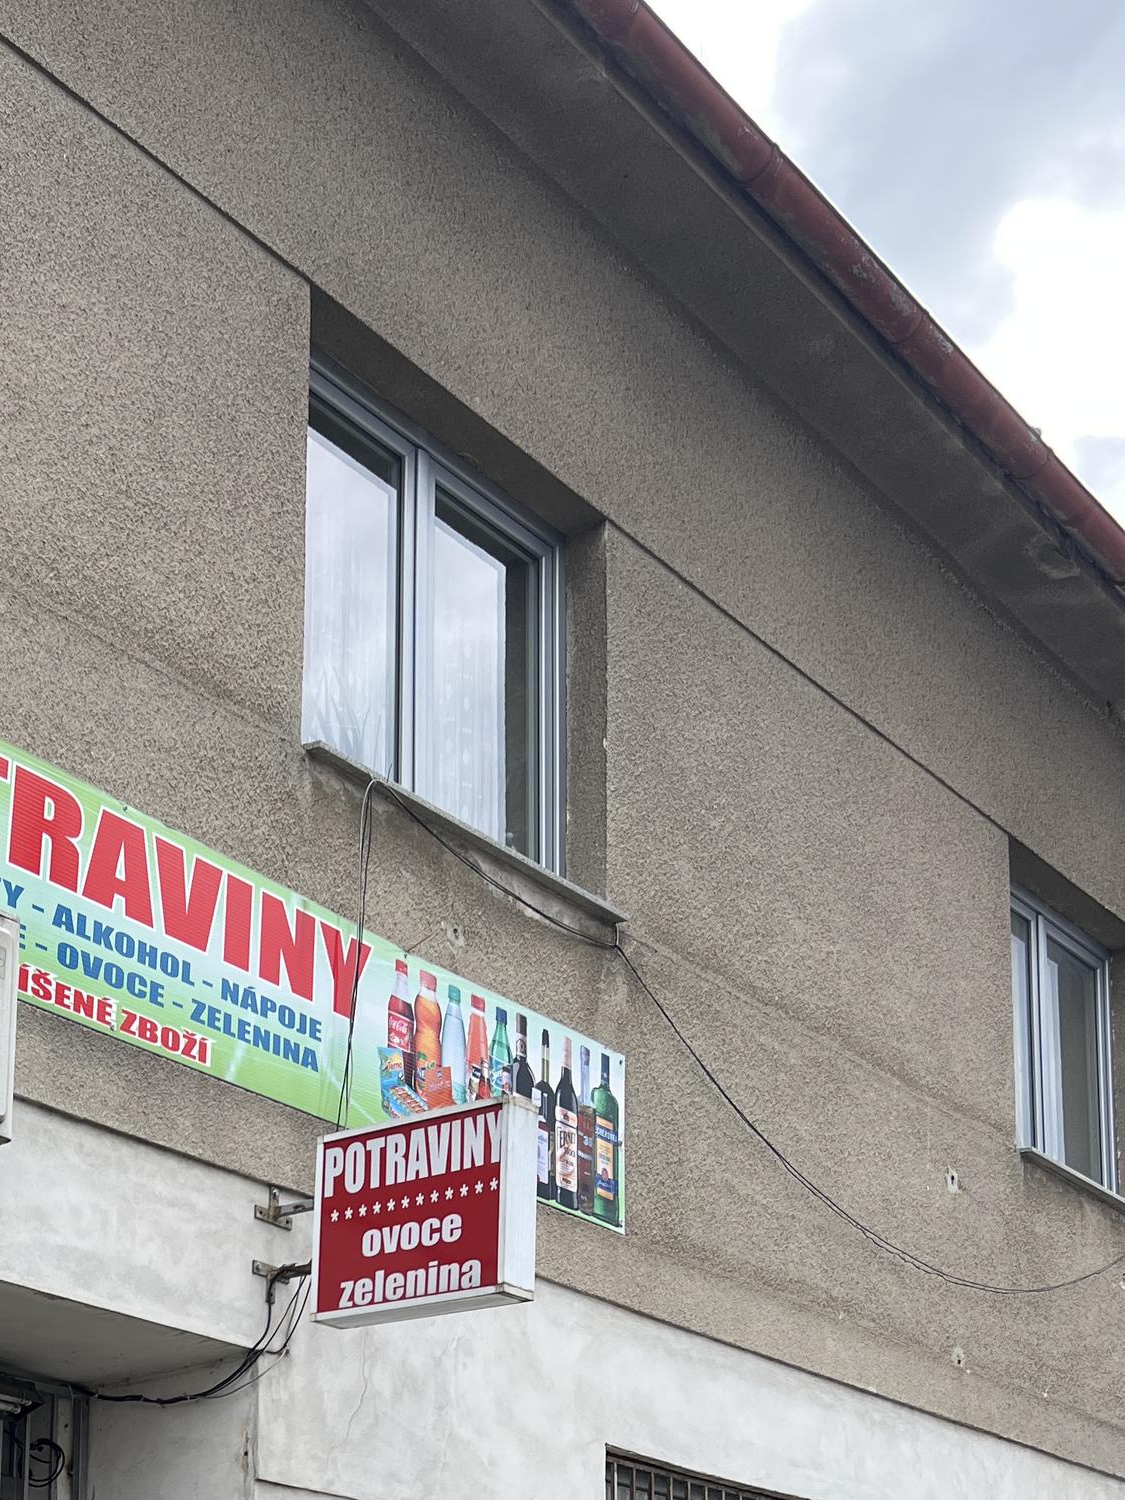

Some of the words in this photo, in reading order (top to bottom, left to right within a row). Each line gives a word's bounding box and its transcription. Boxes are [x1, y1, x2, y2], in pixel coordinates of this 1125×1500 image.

[17, 962, 113, 1027] ÍŠENÉ
[120, 1009, 210, 1065] ZBOŽÍ
[52, 905, 195, 987] ALKOHOL
[221, 977, 323, 1042] NÁPOJE
[57, 942, 165, 1008] OVOCE
[190, 998, 320, 1073] ZELENINA
[324, 1109, 503, 1198] POTRAVINY
[339, 1258, 481, 1308] zelenina
[362, 1213, 462, 1258] ovoce
